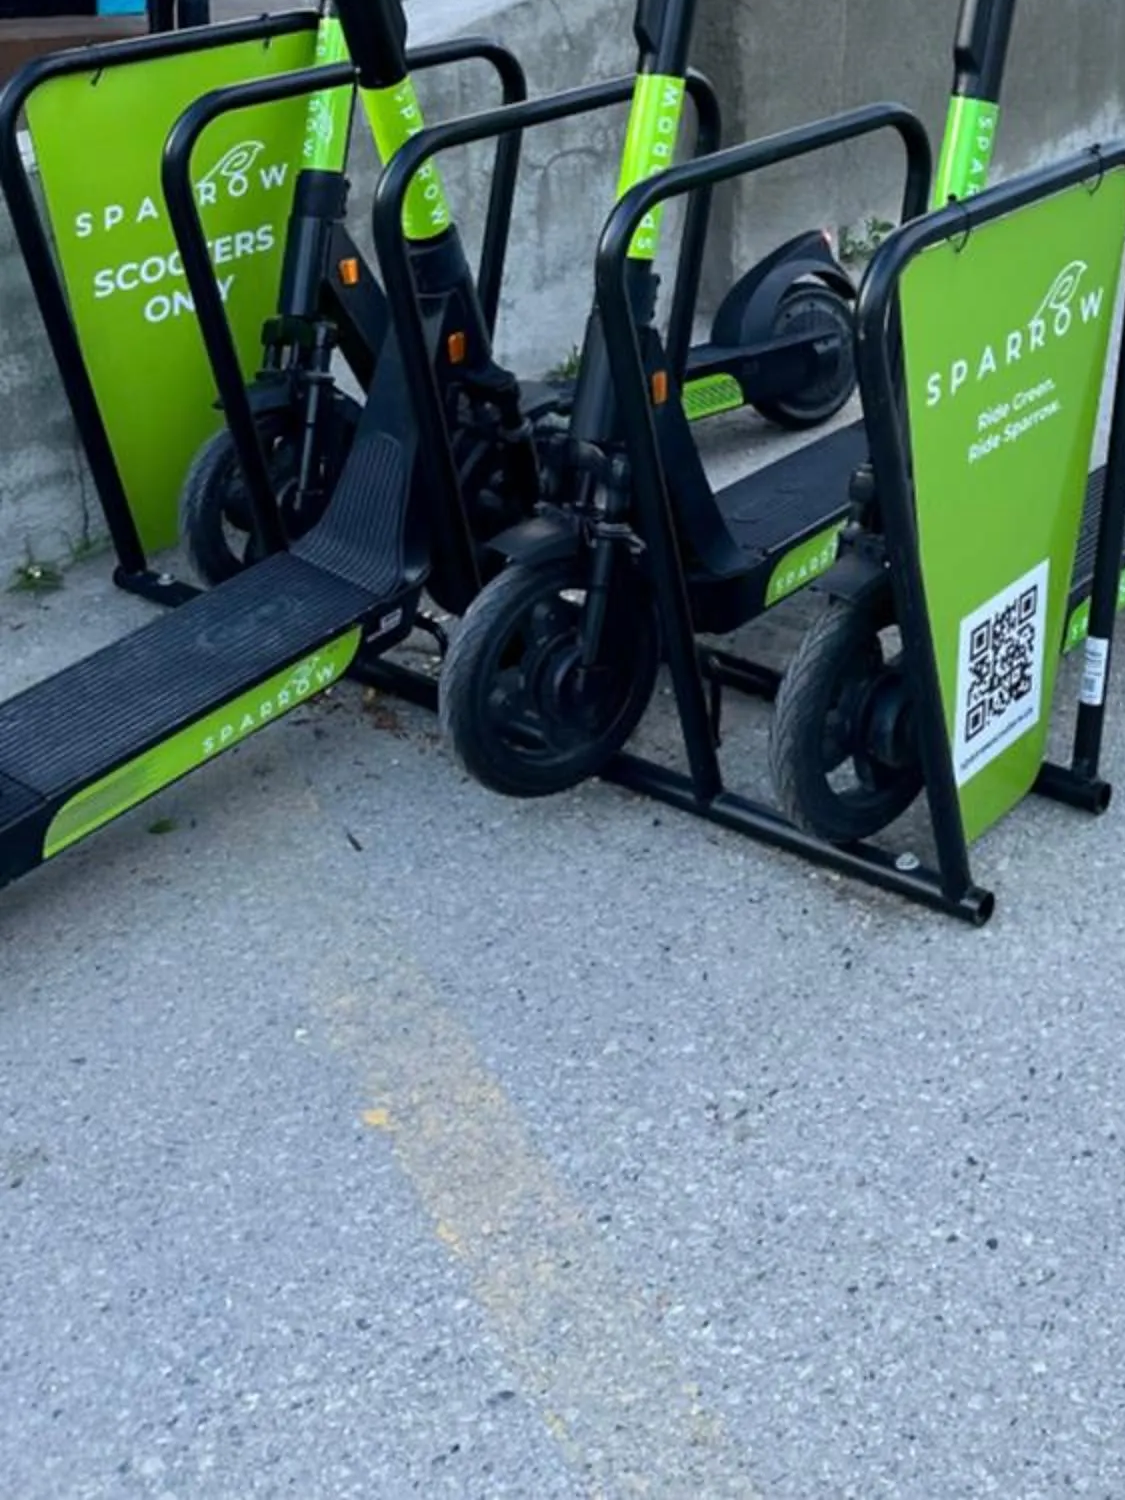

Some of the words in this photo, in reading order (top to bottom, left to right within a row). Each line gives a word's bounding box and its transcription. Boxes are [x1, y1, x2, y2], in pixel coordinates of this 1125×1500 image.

[75, 163, 289, 238] SPAROW
[93, 223, 275, 299] SCOOERS
[143, 273, 236, 323] ONY
[926, 287, 1104, 407] SPARROW
[967, 434, 1001, 465] Ride
[977, 402, 1011, 433] Ride
[202, 662, 335, 754] SPARROW
